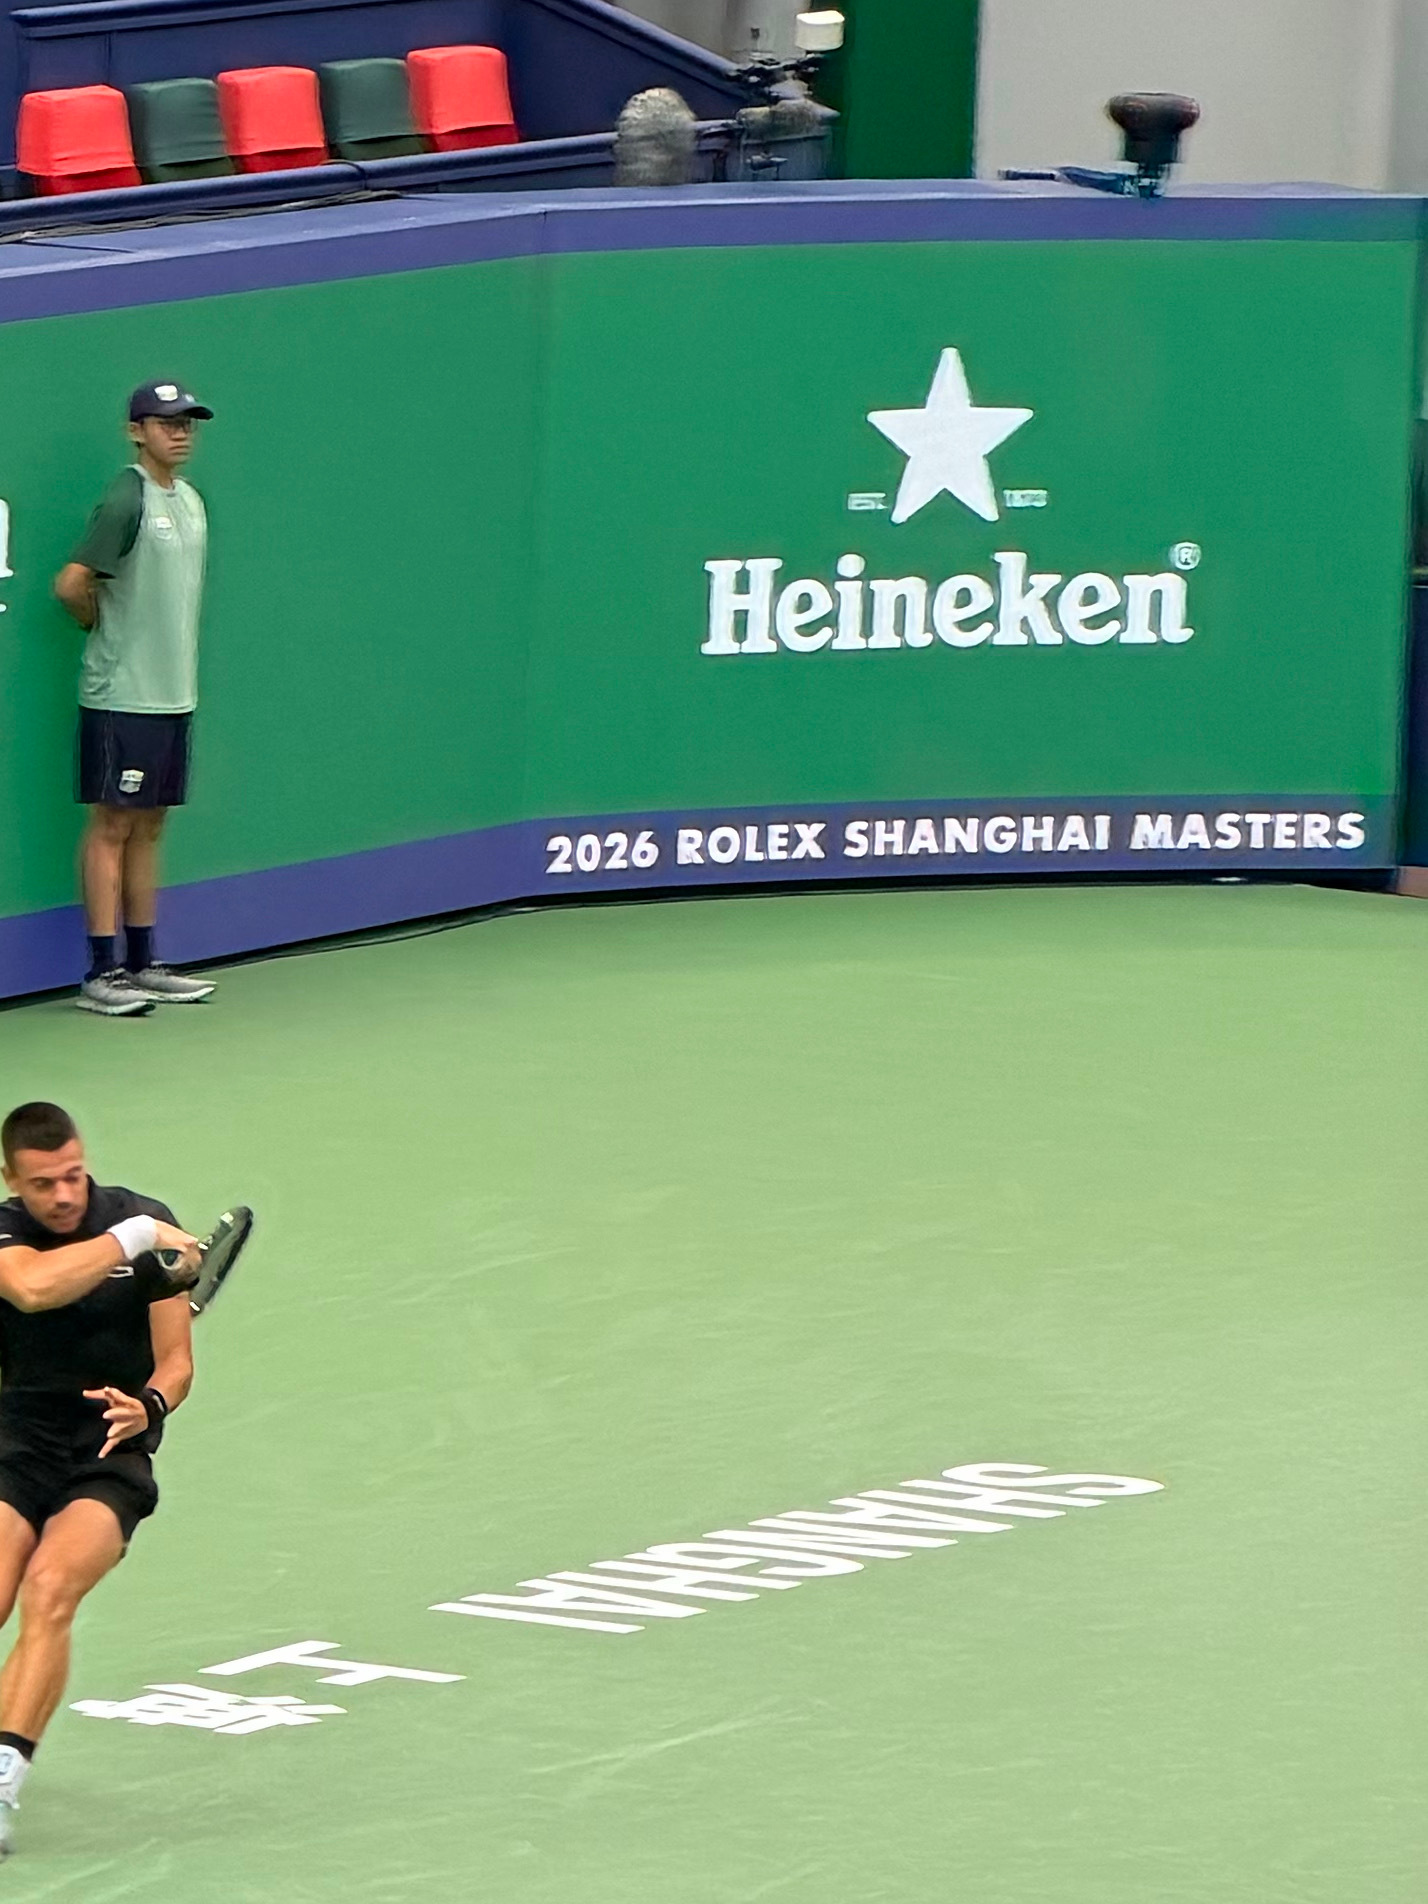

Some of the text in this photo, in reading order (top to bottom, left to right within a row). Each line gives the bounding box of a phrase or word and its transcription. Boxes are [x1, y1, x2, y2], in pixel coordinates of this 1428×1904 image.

[700, 550, 1195, 656] Heineken
[545, 812, 1366, 874] 2026 ROLEX SHANGHAI MASTERS
[427, 1462, 1165, 1634] SHANGHAI
